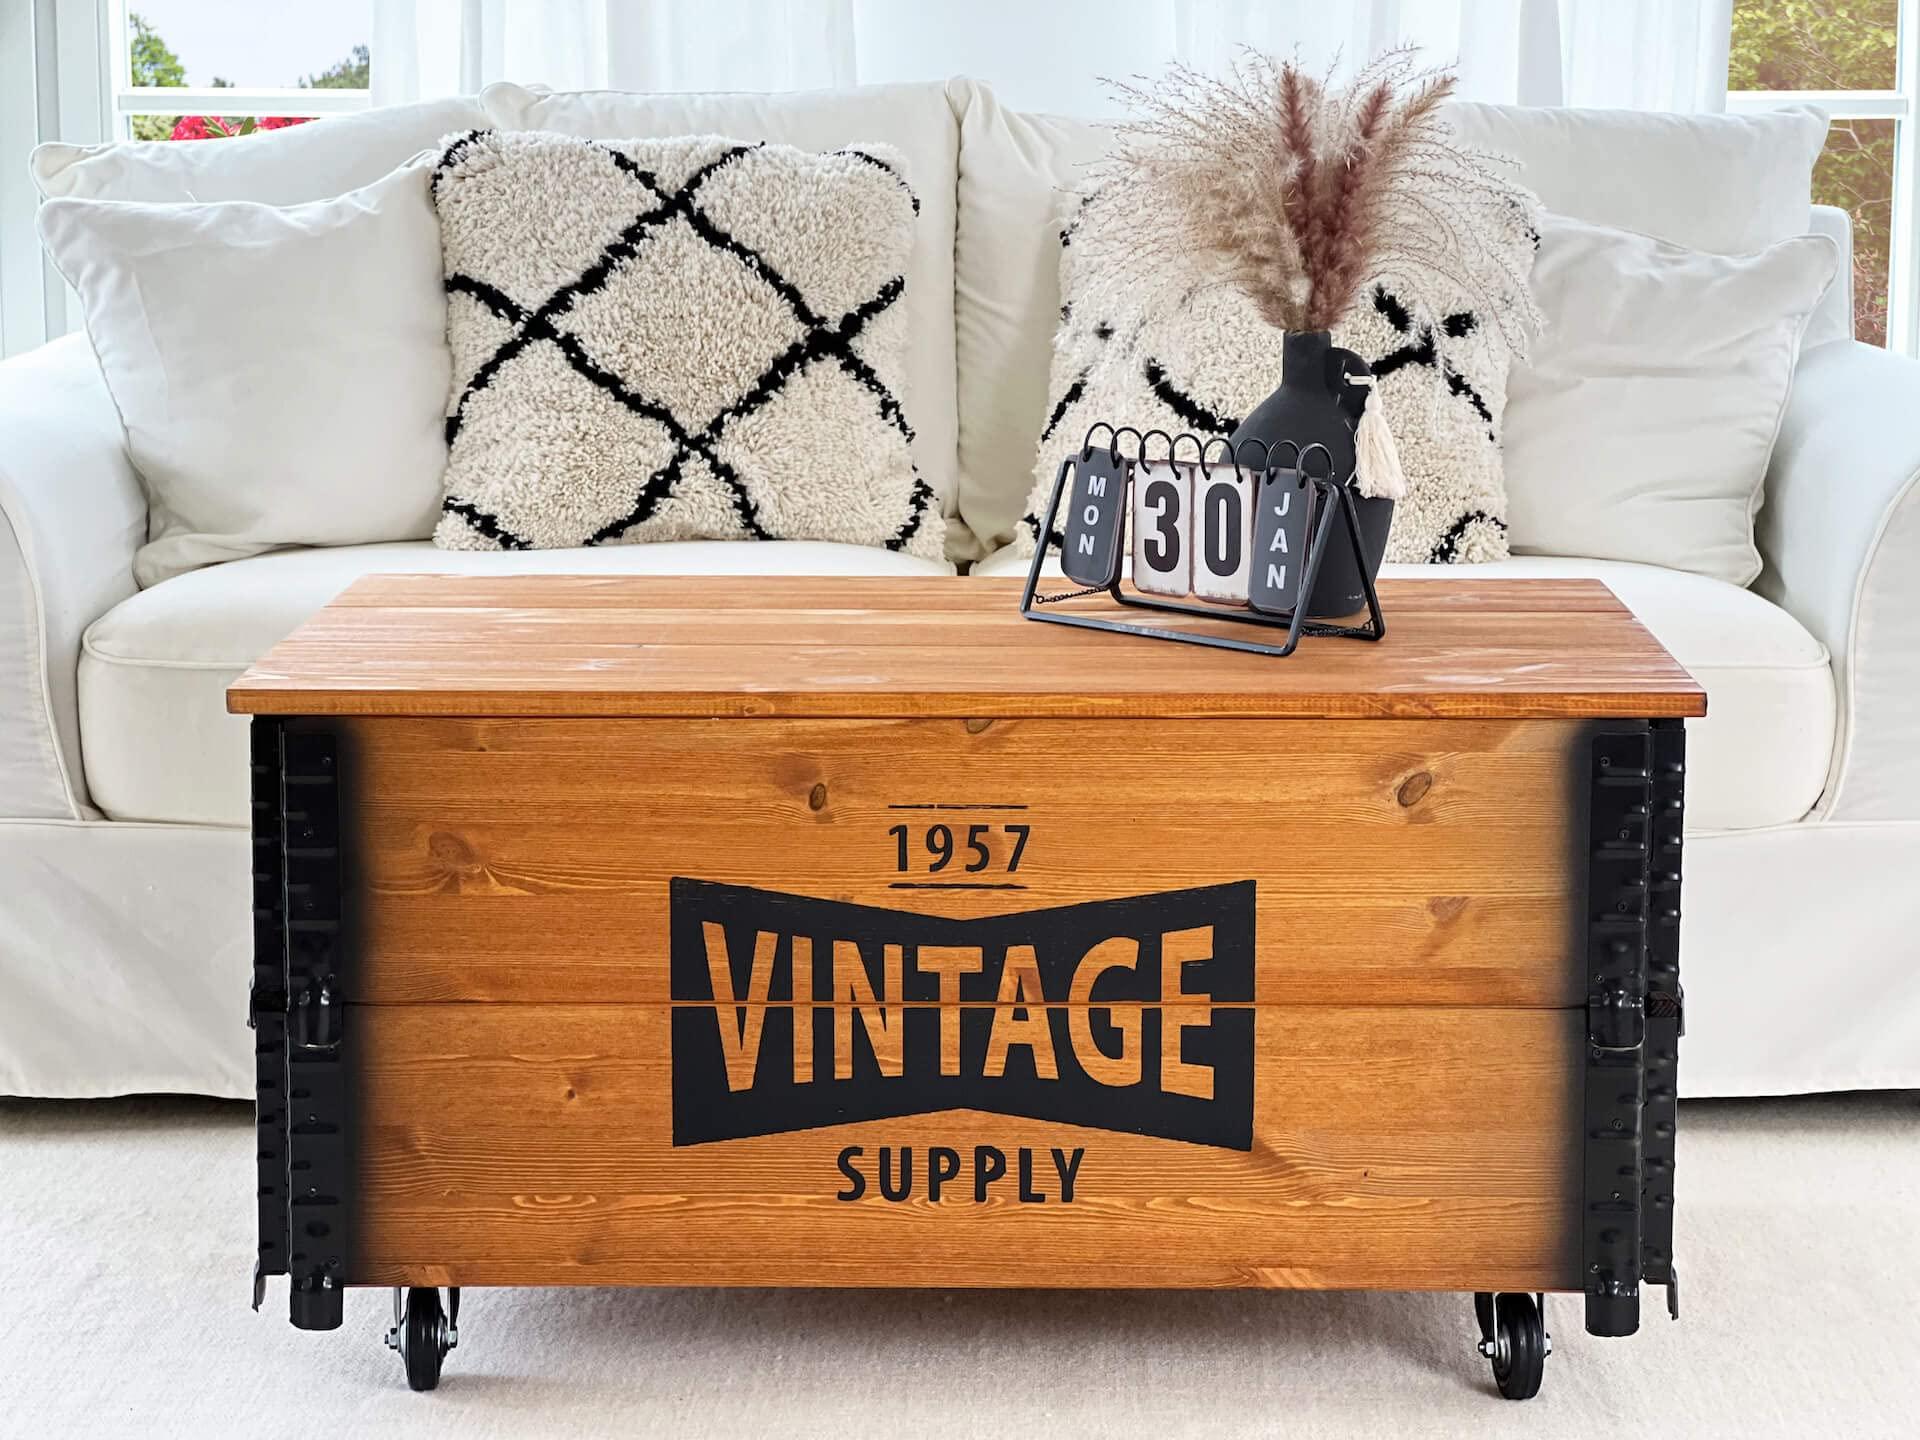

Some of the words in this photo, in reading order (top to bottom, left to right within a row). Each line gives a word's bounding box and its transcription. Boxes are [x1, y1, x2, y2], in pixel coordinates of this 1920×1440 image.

[1078, 475, 1106, 556] MON
[1143, 480, 1243, 577] 30
[1266, 492, 1289, 590] JAN
[888, 824, 1031, 873] 1957
[701, 921, 1215, 1100] VINTAGE
[836, 1146, 1085, 1203] SUPPLY
